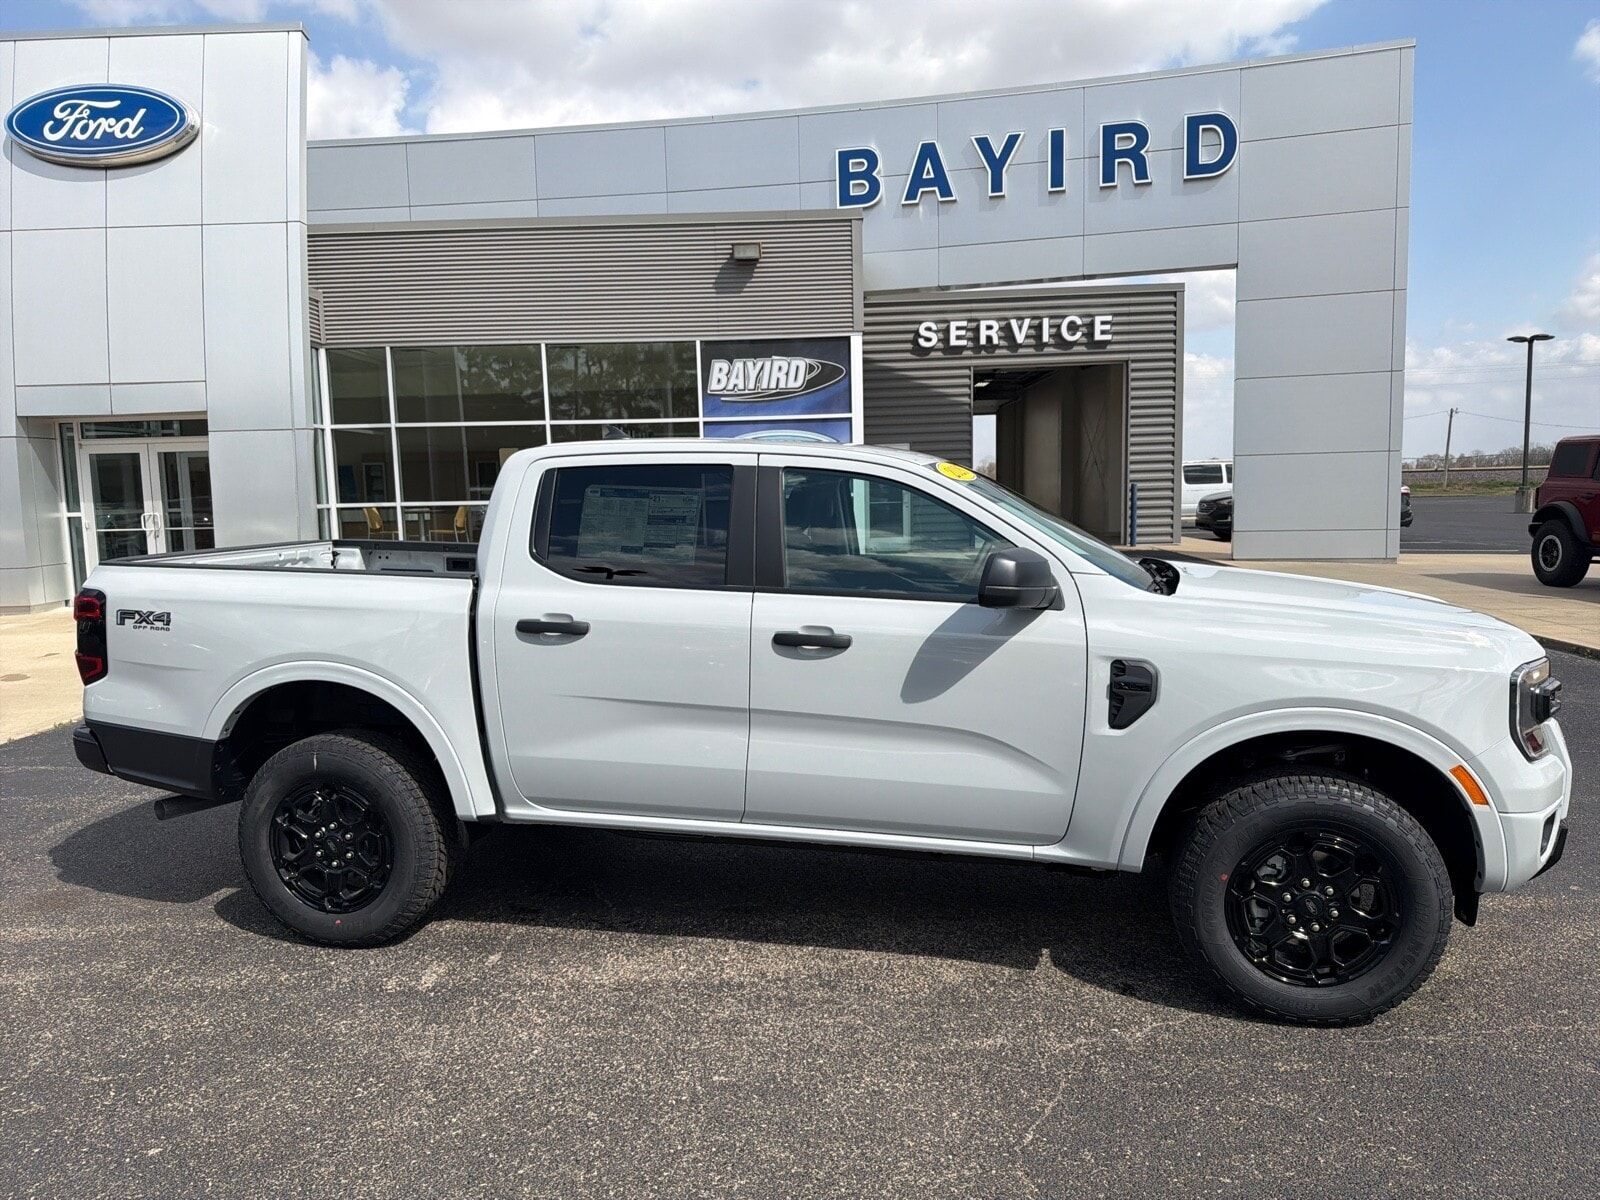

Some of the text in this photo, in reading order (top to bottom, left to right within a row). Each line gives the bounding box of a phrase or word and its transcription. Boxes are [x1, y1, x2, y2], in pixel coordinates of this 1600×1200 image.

[43, 100, 147, 141] Ford
[835, 111, 1240, 209] BAYIRD
[916, 315, 1114, 348] SERVICE
[707, 357, 809, 394] BAYIRD
[116, 609, 172, 626] FX4
